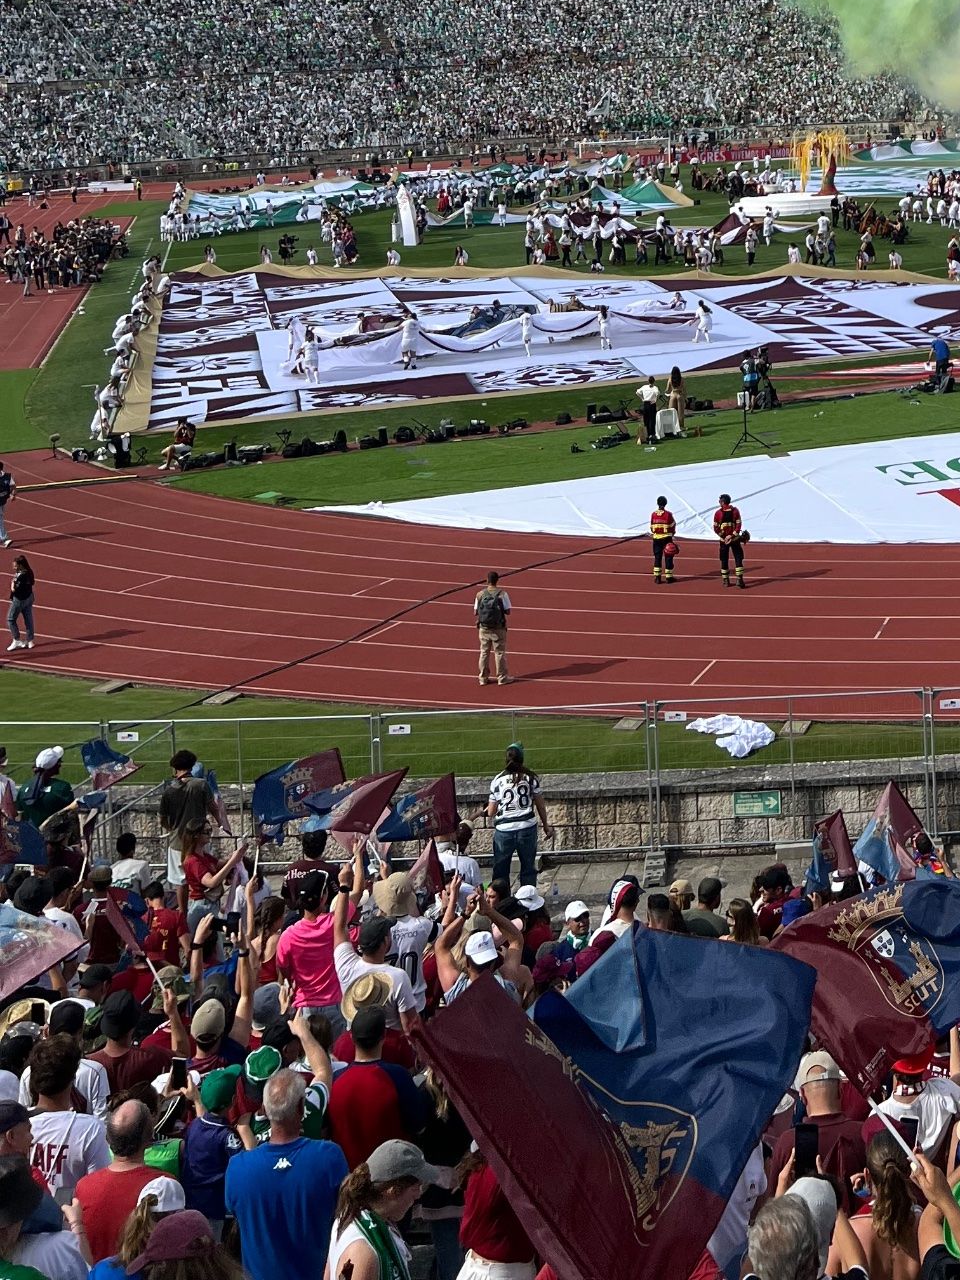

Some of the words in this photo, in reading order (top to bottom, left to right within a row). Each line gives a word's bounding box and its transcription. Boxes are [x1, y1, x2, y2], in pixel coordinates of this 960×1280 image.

[503, 784, 529, 810] 28
[904, 977, 939, 1013] SCUT
[32, 1143, 69, 1174] AFF
